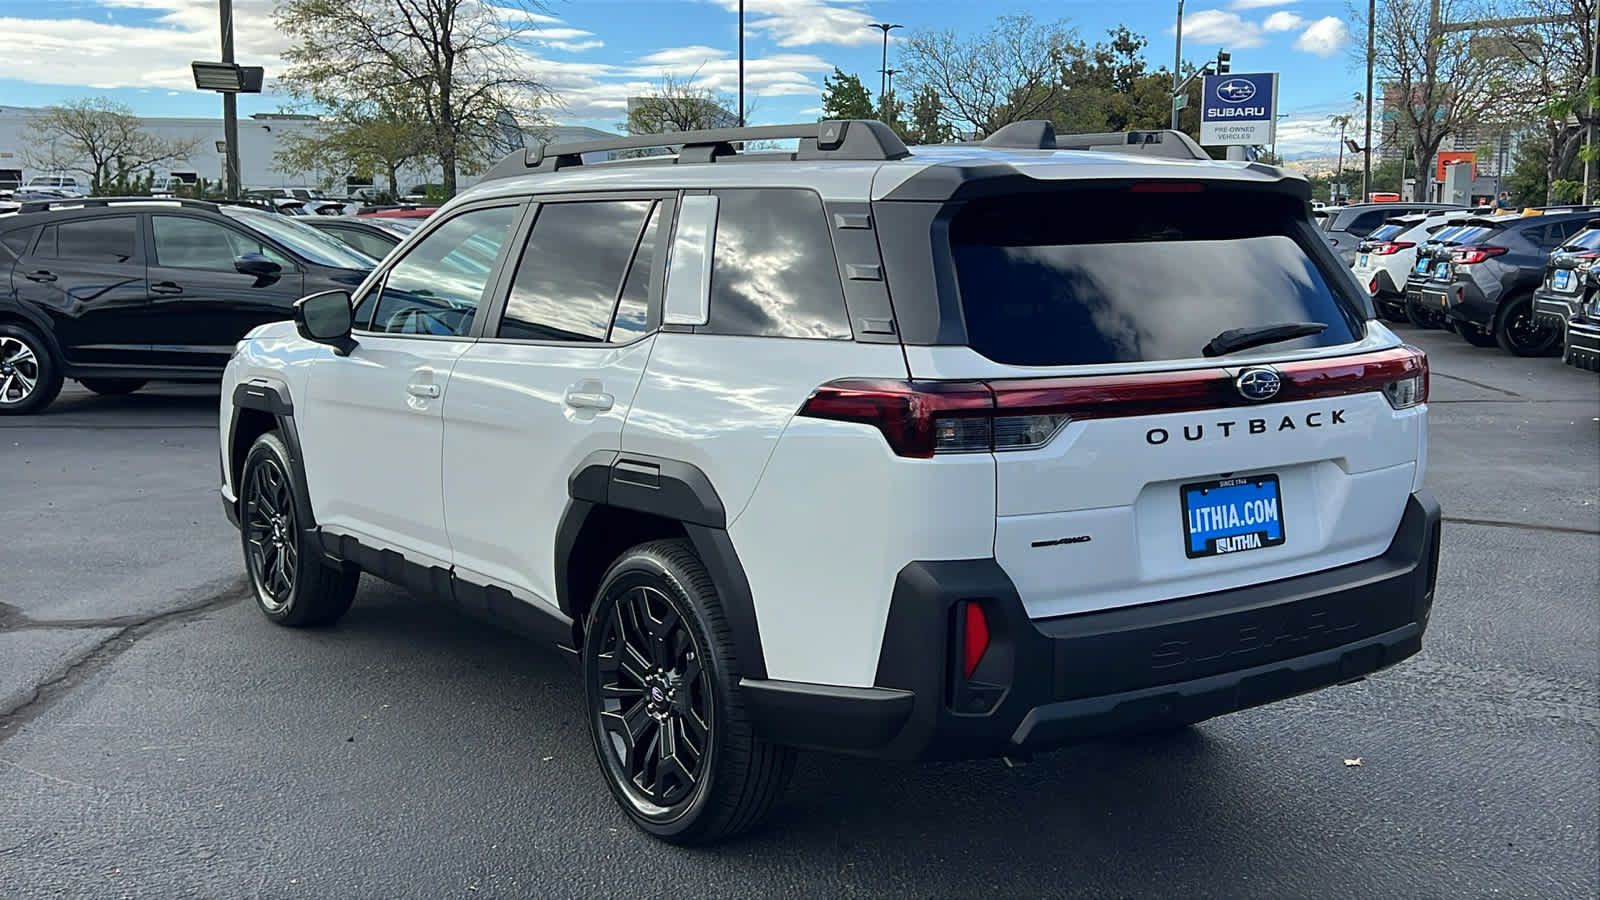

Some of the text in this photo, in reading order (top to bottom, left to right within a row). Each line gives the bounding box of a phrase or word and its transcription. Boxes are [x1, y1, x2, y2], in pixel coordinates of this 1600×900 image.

[1207, 107, 1264, 117] SUBARU
[1146, 409, 1345, 445] OUTBACK
[1188, 498, 1278, 533] LITHIA.COM
[1227, 533, 1261, 552] LITHIA
[1151, 607, 1361, 670] SUBARU
